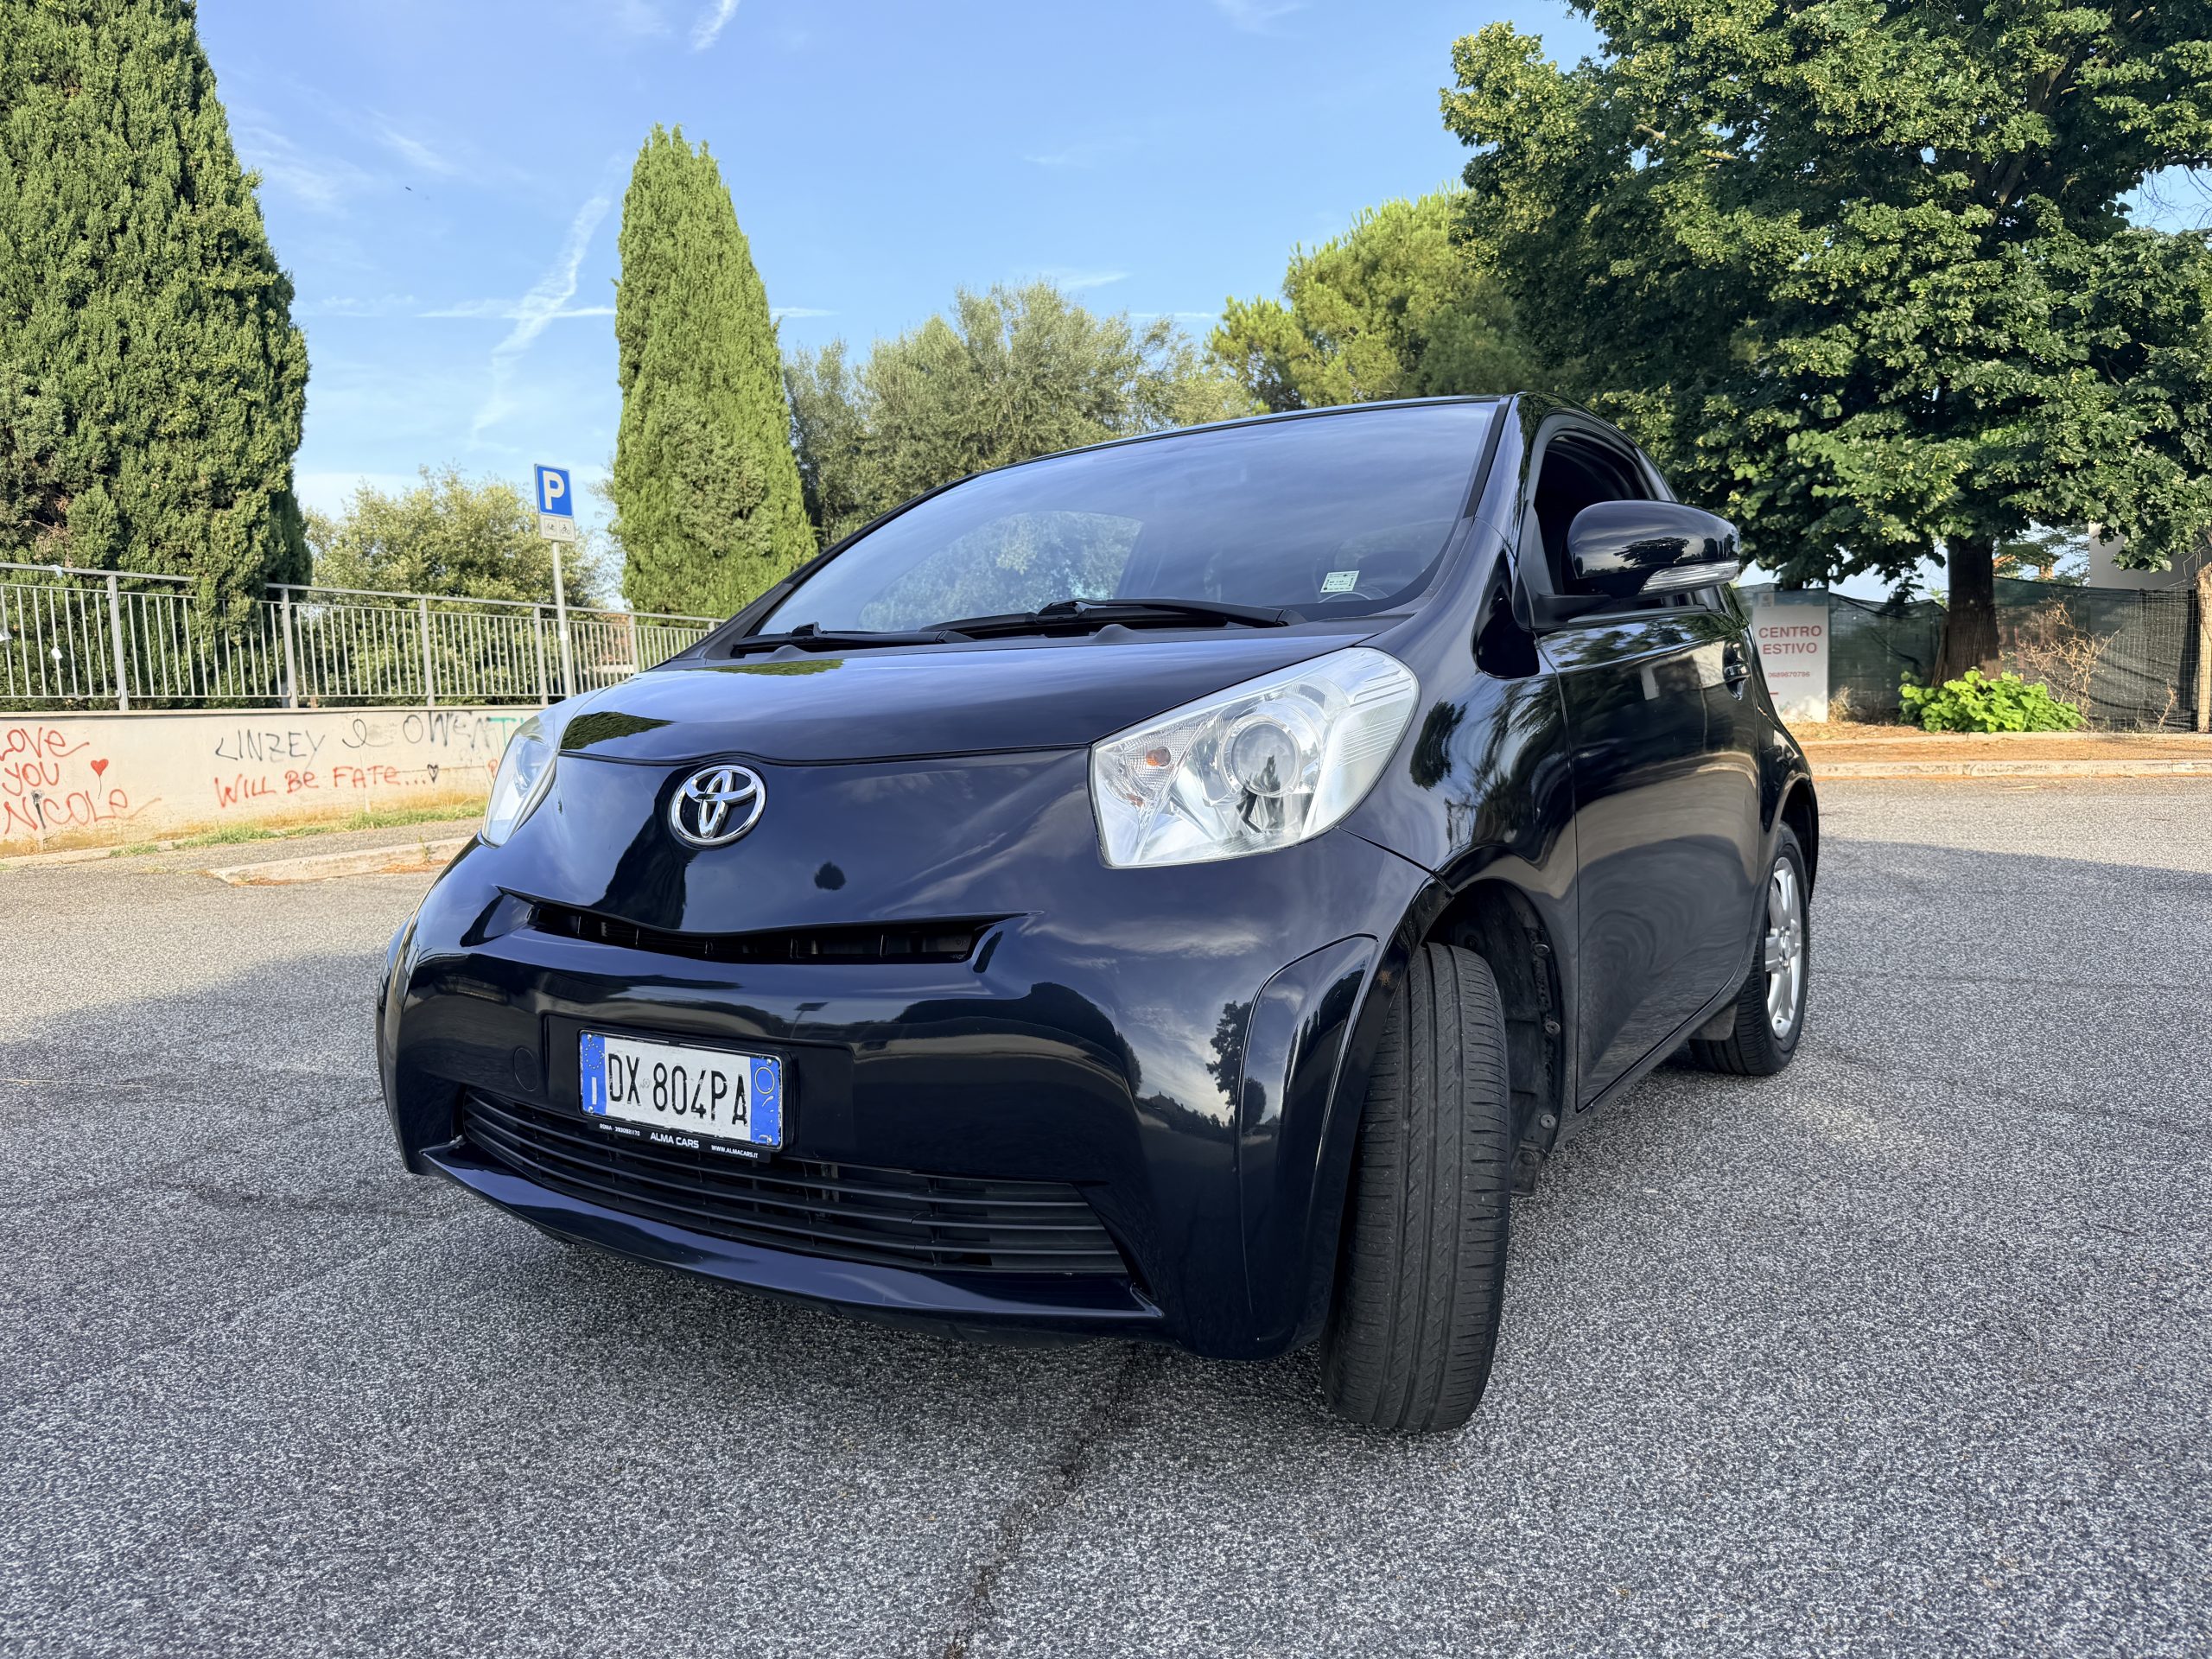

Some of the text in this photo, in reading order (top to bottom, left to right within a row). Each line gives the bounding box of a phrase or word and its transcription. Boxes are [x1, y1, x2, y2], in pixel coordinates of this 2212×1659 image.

[543, 470, 565, 510] P
[1758, 625, 1822, 639] CENTRO
[1763, 642, 1817, 655] ESTIVO
[608, 1052, 748, 1127] DX 804PA
[650, 1132, 699, 1149] ALMA CARS
[710, 1144, 759, 1159] WWW.ALMACARS.IT
